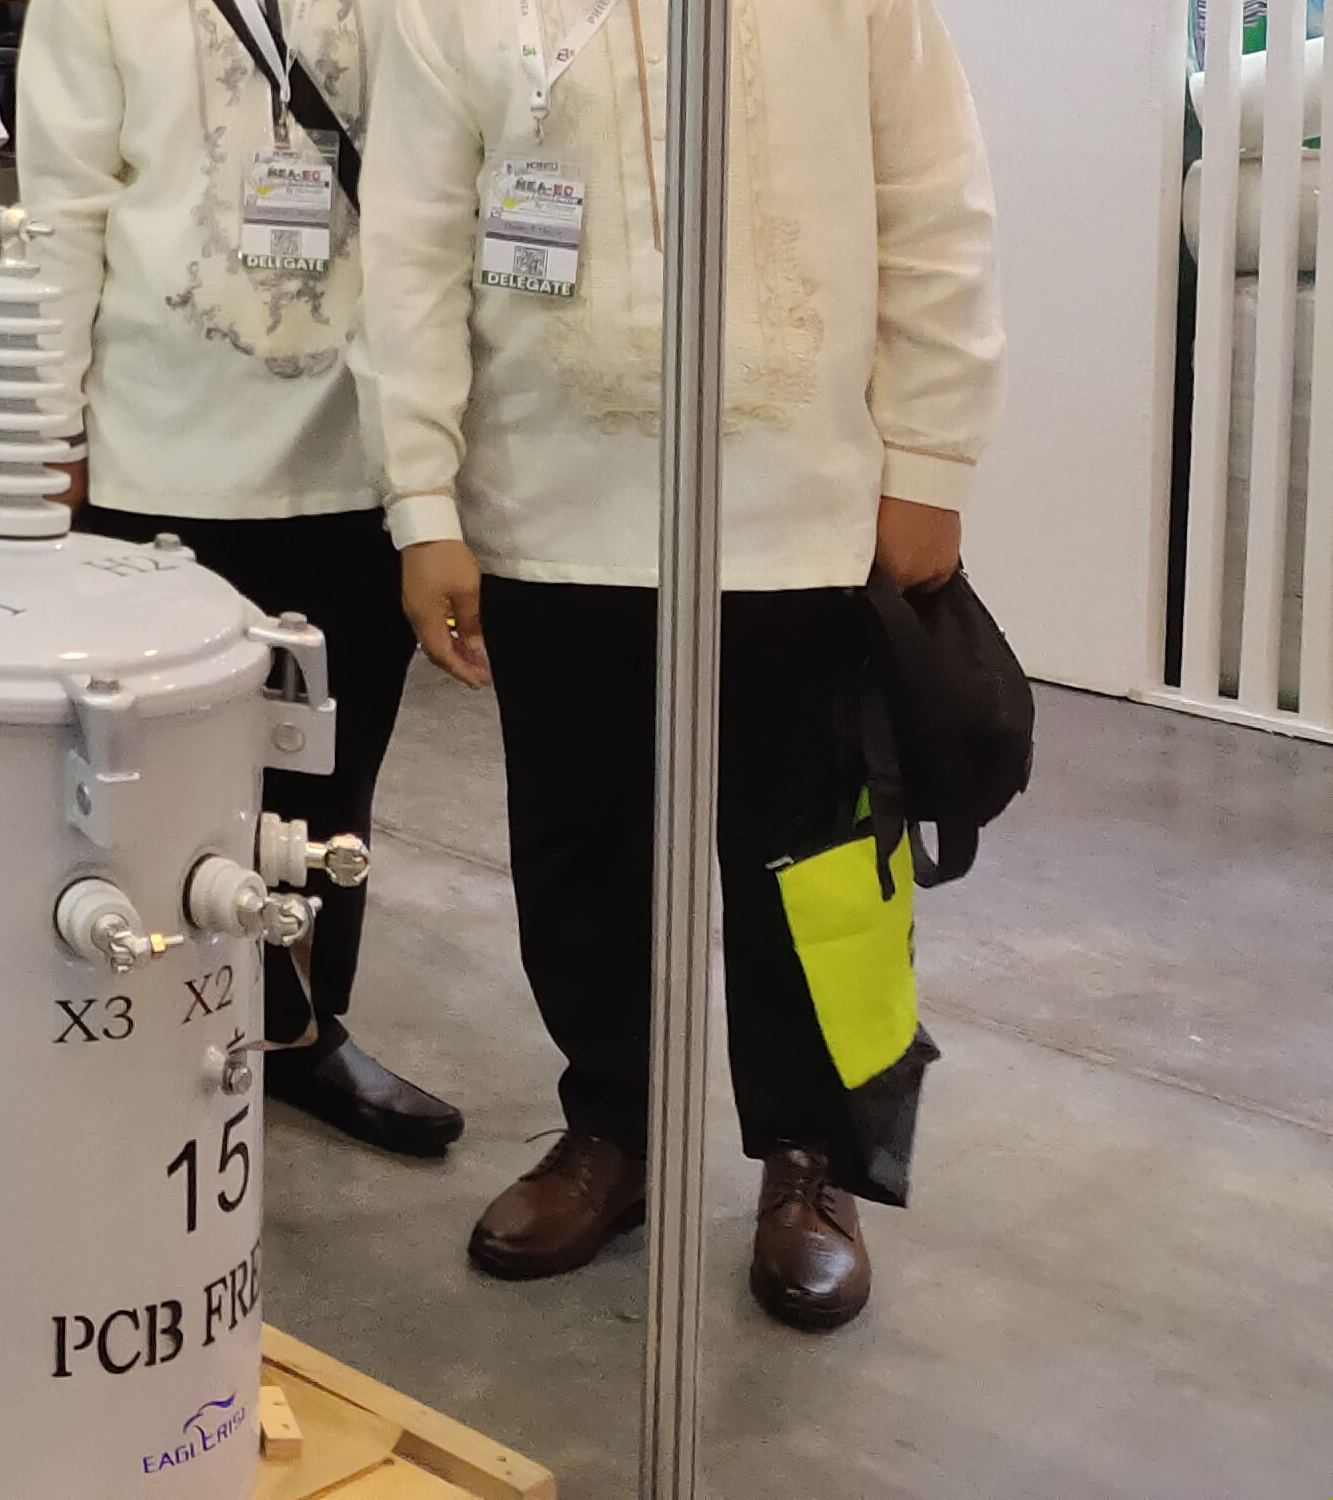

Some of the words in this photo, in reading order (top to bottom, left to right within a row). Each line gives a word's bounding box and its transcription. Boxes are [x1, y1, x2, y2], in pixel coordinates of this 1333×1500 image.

[246, 255, 325, 271] DELEGATE
[487, 272, 571, 296] DELEGATE
[82, 555, 178, 578] H2
[180, 963, 235, 1026] X2
[51, 995, 134, 1043] X3
[165, 1102, 251, 1234] 15
[51, 1299, 184, 1379] PCB
[201, 1236, 261, 1348] FRE
